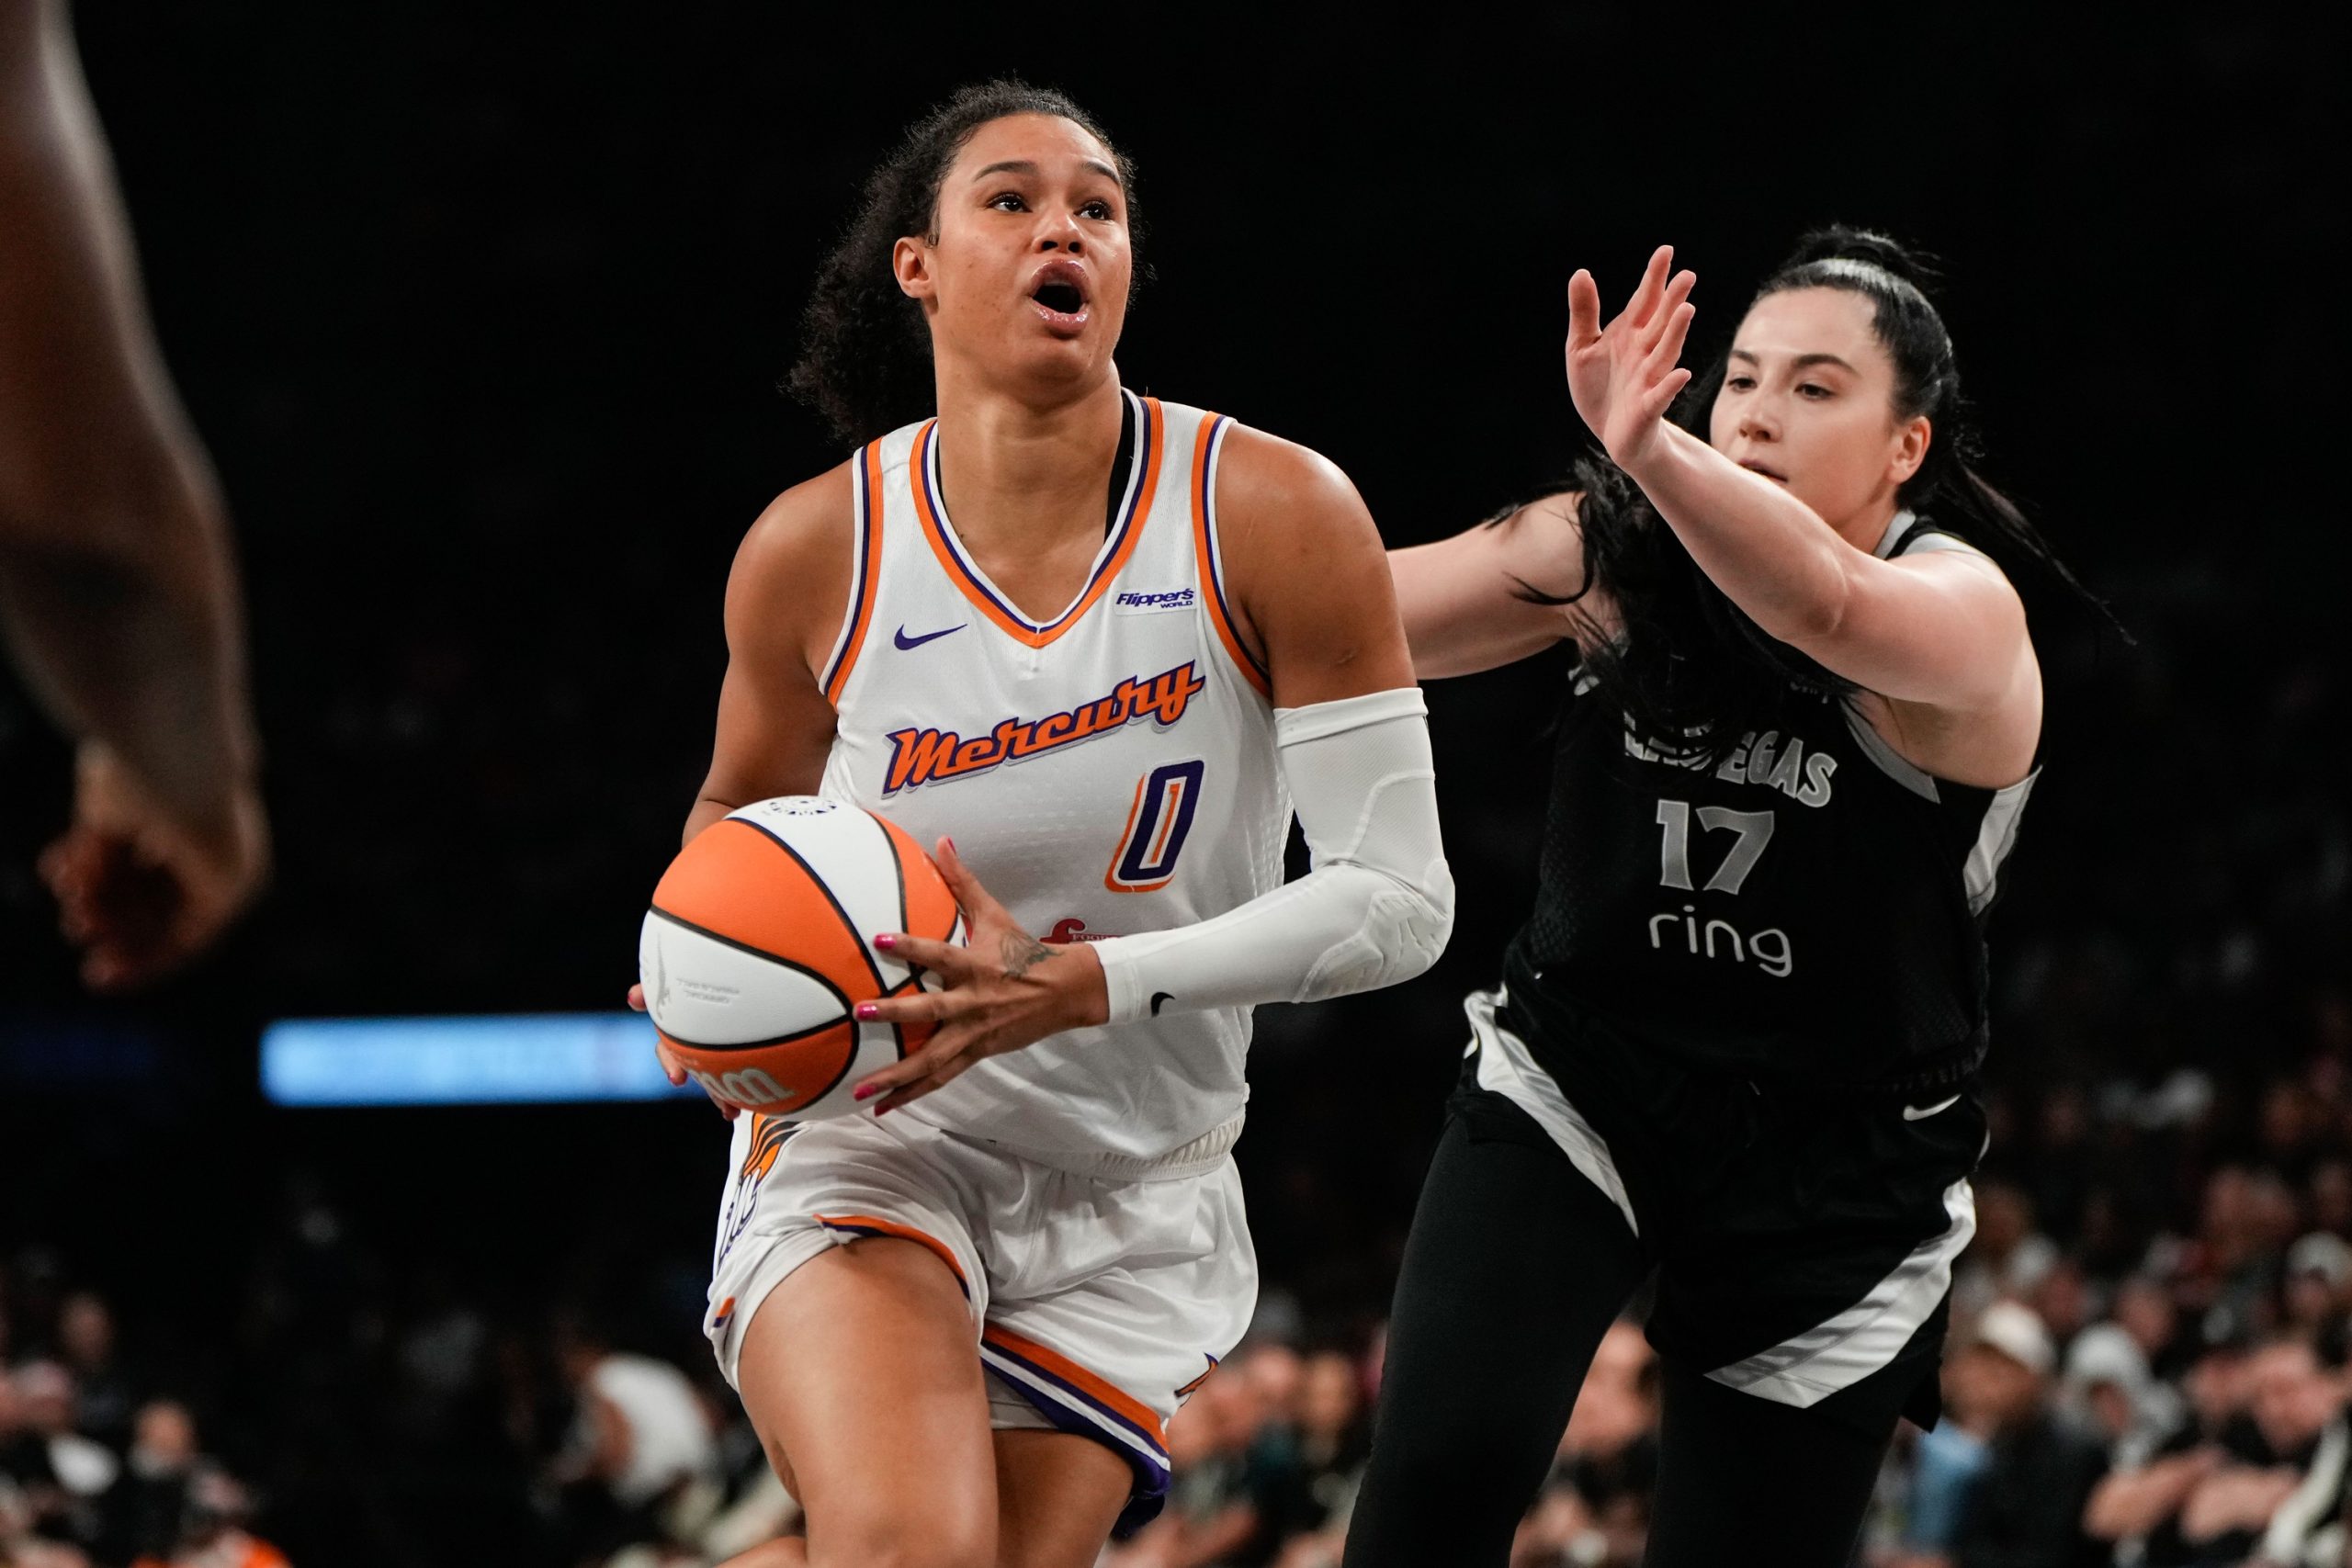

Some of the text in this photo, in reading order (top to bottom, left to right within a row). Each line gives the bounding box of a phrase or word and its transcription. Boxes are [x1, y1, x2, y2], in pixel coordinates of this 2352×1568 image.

[1160, 600, 1193, 609] WORLD
[881, 660, 1205, 799] Mercury
[1711, 729, 1838, 808] EGAS
[1105, 760, 1204, 893] 0
[1656, 798, 1774, 896] 17
[1649, 905, 1792, 977] ring
